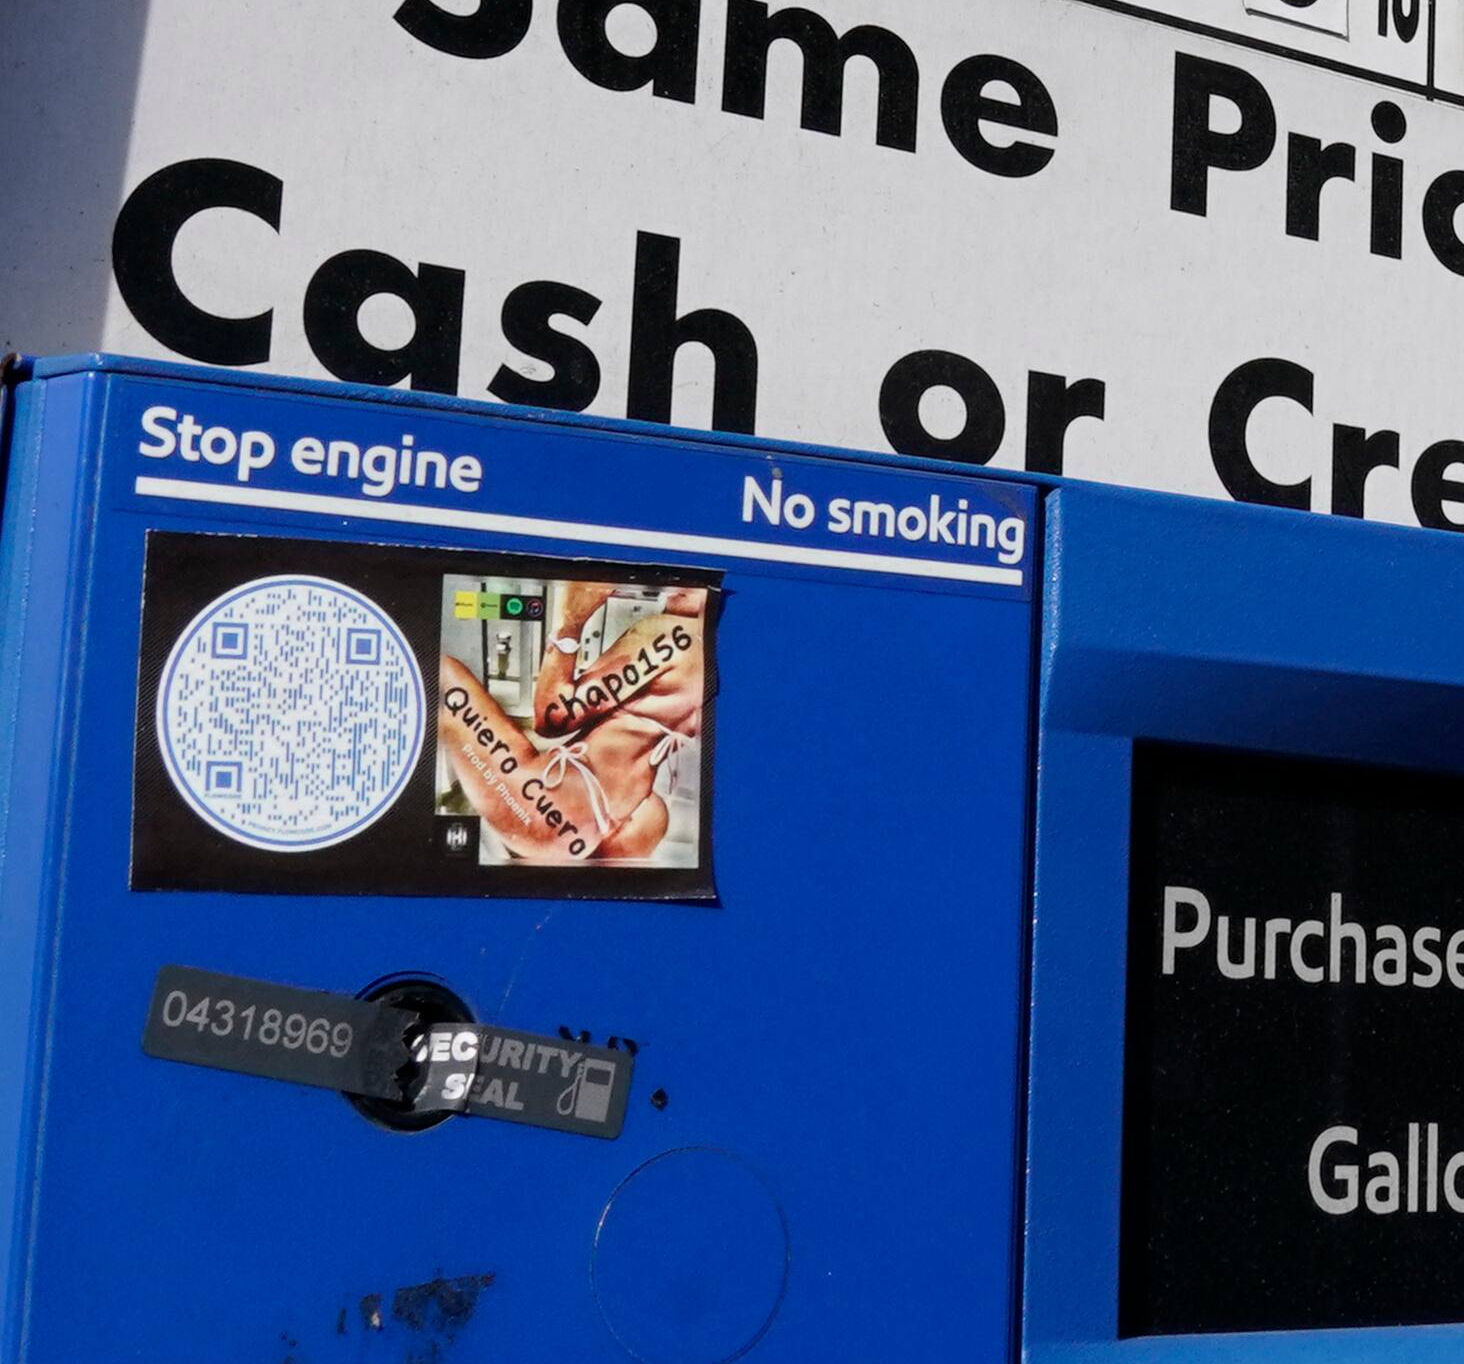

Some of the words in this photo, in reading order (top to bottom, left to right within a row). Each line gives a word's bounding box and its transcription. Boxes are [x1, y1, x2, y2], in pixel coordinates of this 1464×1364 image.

[111, 157, 758, 436] Cash
[879, 349, 1105, 476] or
[140, 407, 273, 472] Stop
[290, 435, 482, 497] engine
[742, 475, 814, 529] No
[827, 493, 1026, 565] smoking
[444, 686, 519, 776] Quiero
[522, 778, 587, 856] Cuero
[461, 743, 485, 771] Prod
[496, 782, 532, 827] Phoenix
[162, 990, 353, 1058] 04318969
